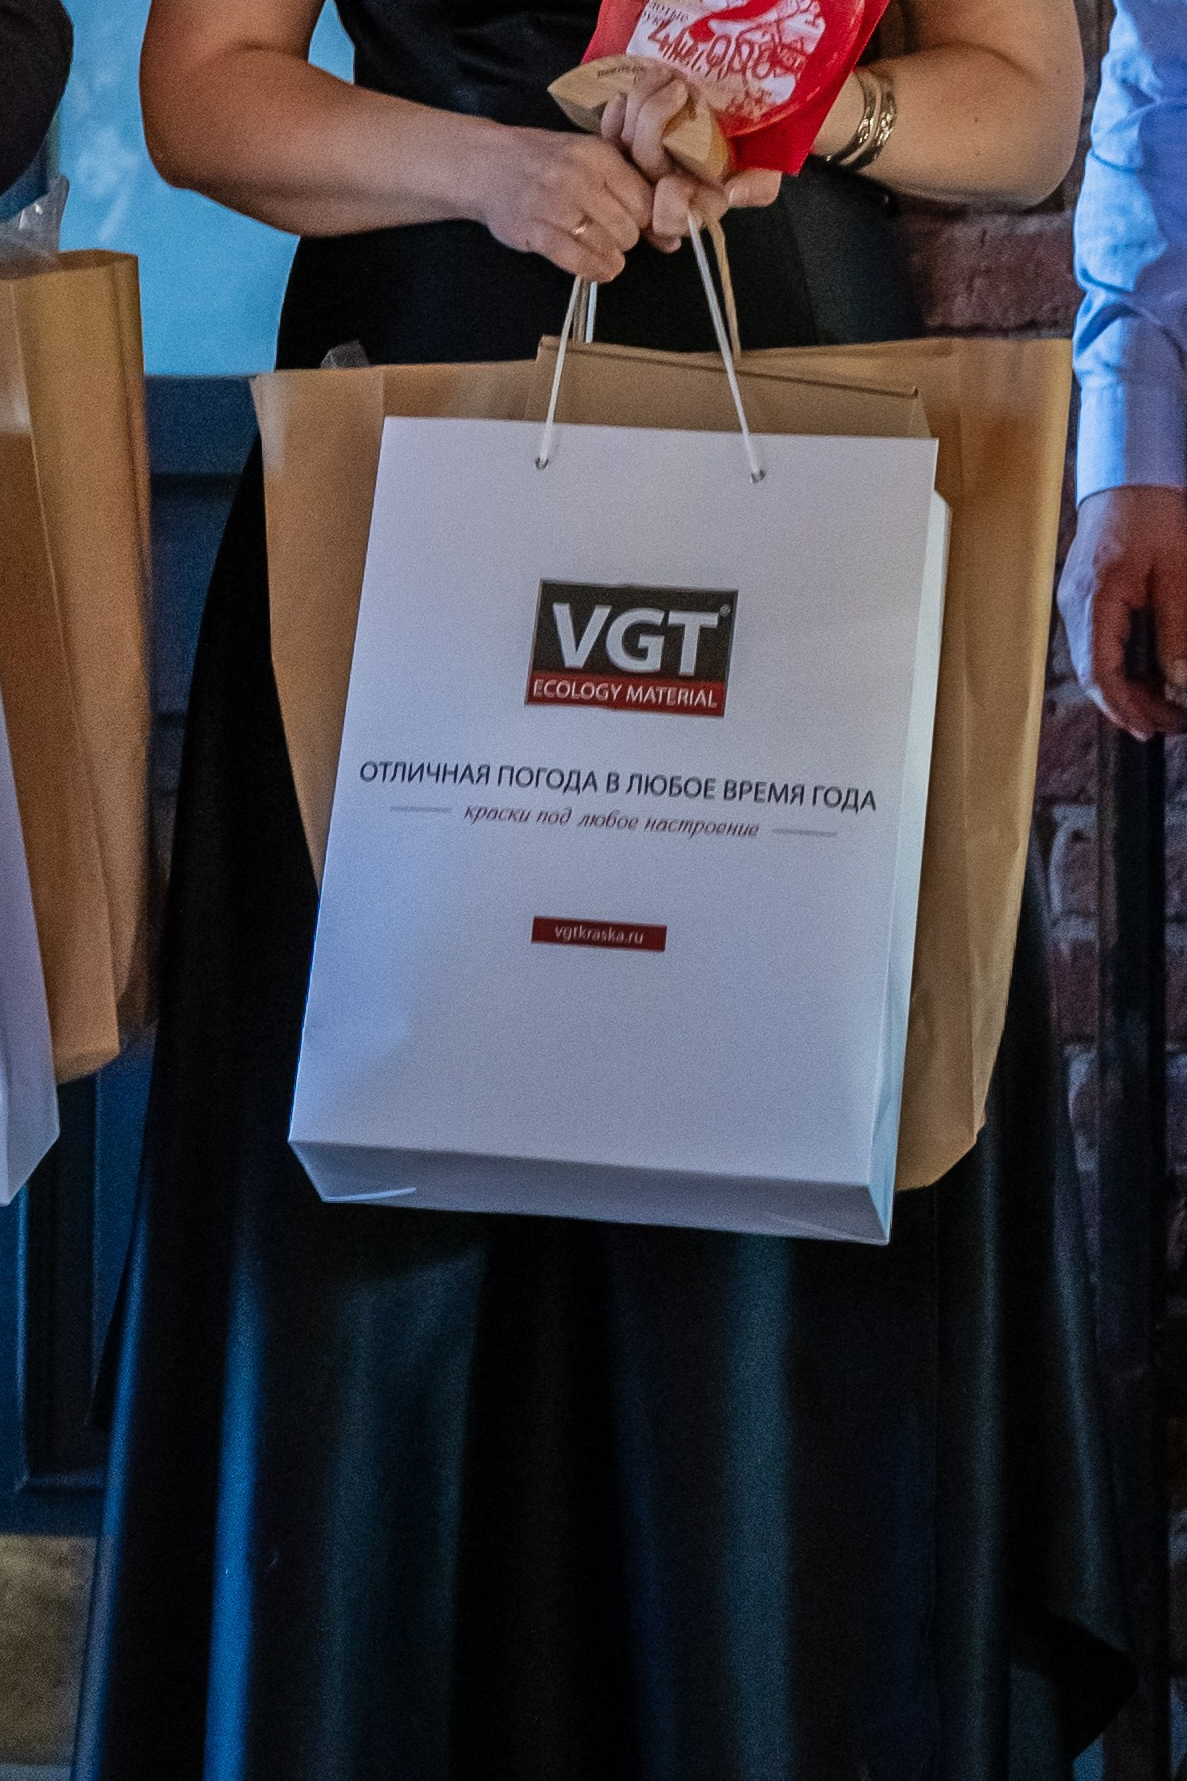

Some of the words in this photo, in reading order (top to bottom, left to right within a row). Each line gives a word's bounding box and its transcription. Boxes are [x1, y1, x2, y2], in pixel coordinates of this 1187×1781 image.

[553, 602, 718, 676] VGT
[533, 679, 623, 701] ECOLOGY
[626, 684, 717, 708] MATERIAL
[360, 760, 491, 785] ОТЛИЧНАЯ
[498, 764, 598, 795] ПОГОДА
[606, 771, 620, 794] В
[626, 772, 717, 800] ЛЮБОЕ
[723, 778, 805, 806] ВРЕМЯ
[812, 784, 877, 813] ГОДА
[464, 804, 532, 825] краски
[536, 806, 572, 825] под
[578, 808, 639, 830] любое
[644, 816, 760, 839] настроение
[554, 922, 644, 945] vgtkraska.ru
